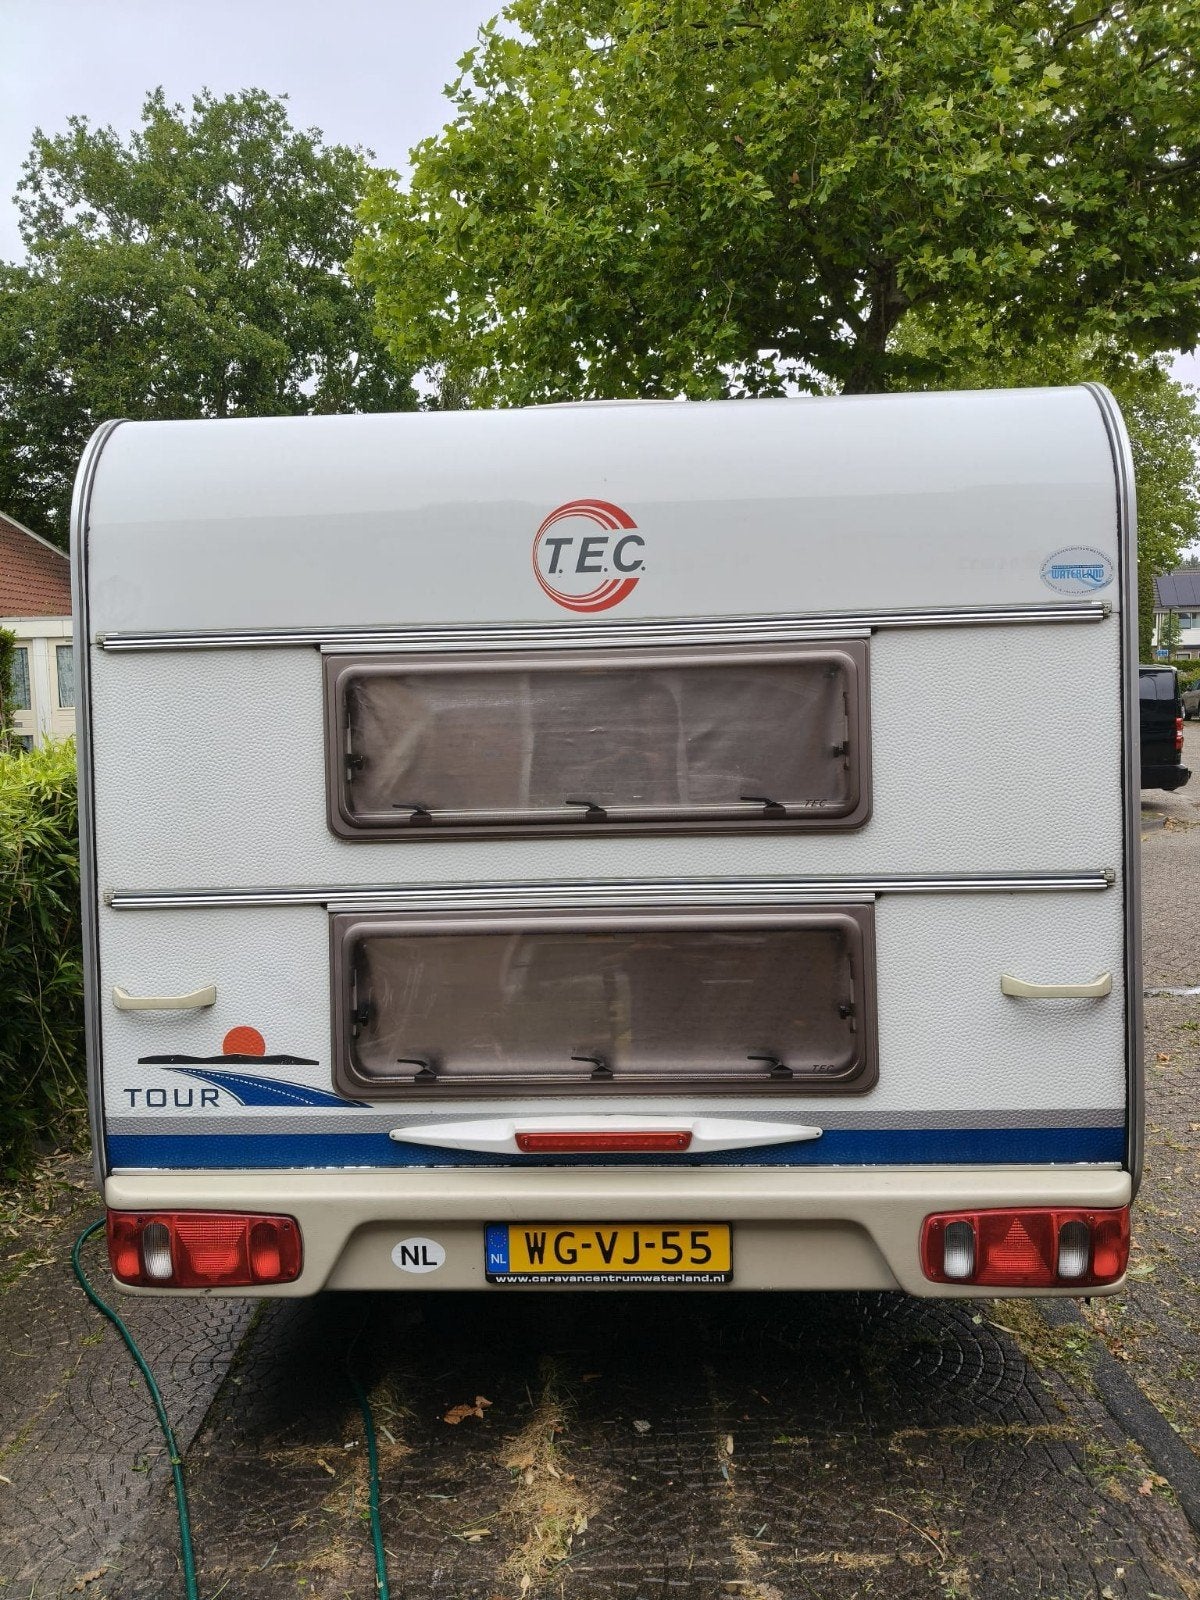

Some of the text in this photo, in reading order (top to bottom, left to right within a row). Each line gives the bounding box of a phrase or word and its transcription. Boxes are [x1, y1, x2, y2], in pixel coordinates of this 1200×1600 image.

[545, 535, 646, 574] T.E.C.
[1051, 569, 1104, 579] WATERLAND
[123, 1088, 220, 1108] TOUR
[401, 1245, 438, 1266] NL
[524, 1231, 712, 1265] WG-VJ-55
[490, 1253, 507, 1264] NL
[495, 1274, 725, 1283] www.caravancentrumwaterland.nl
